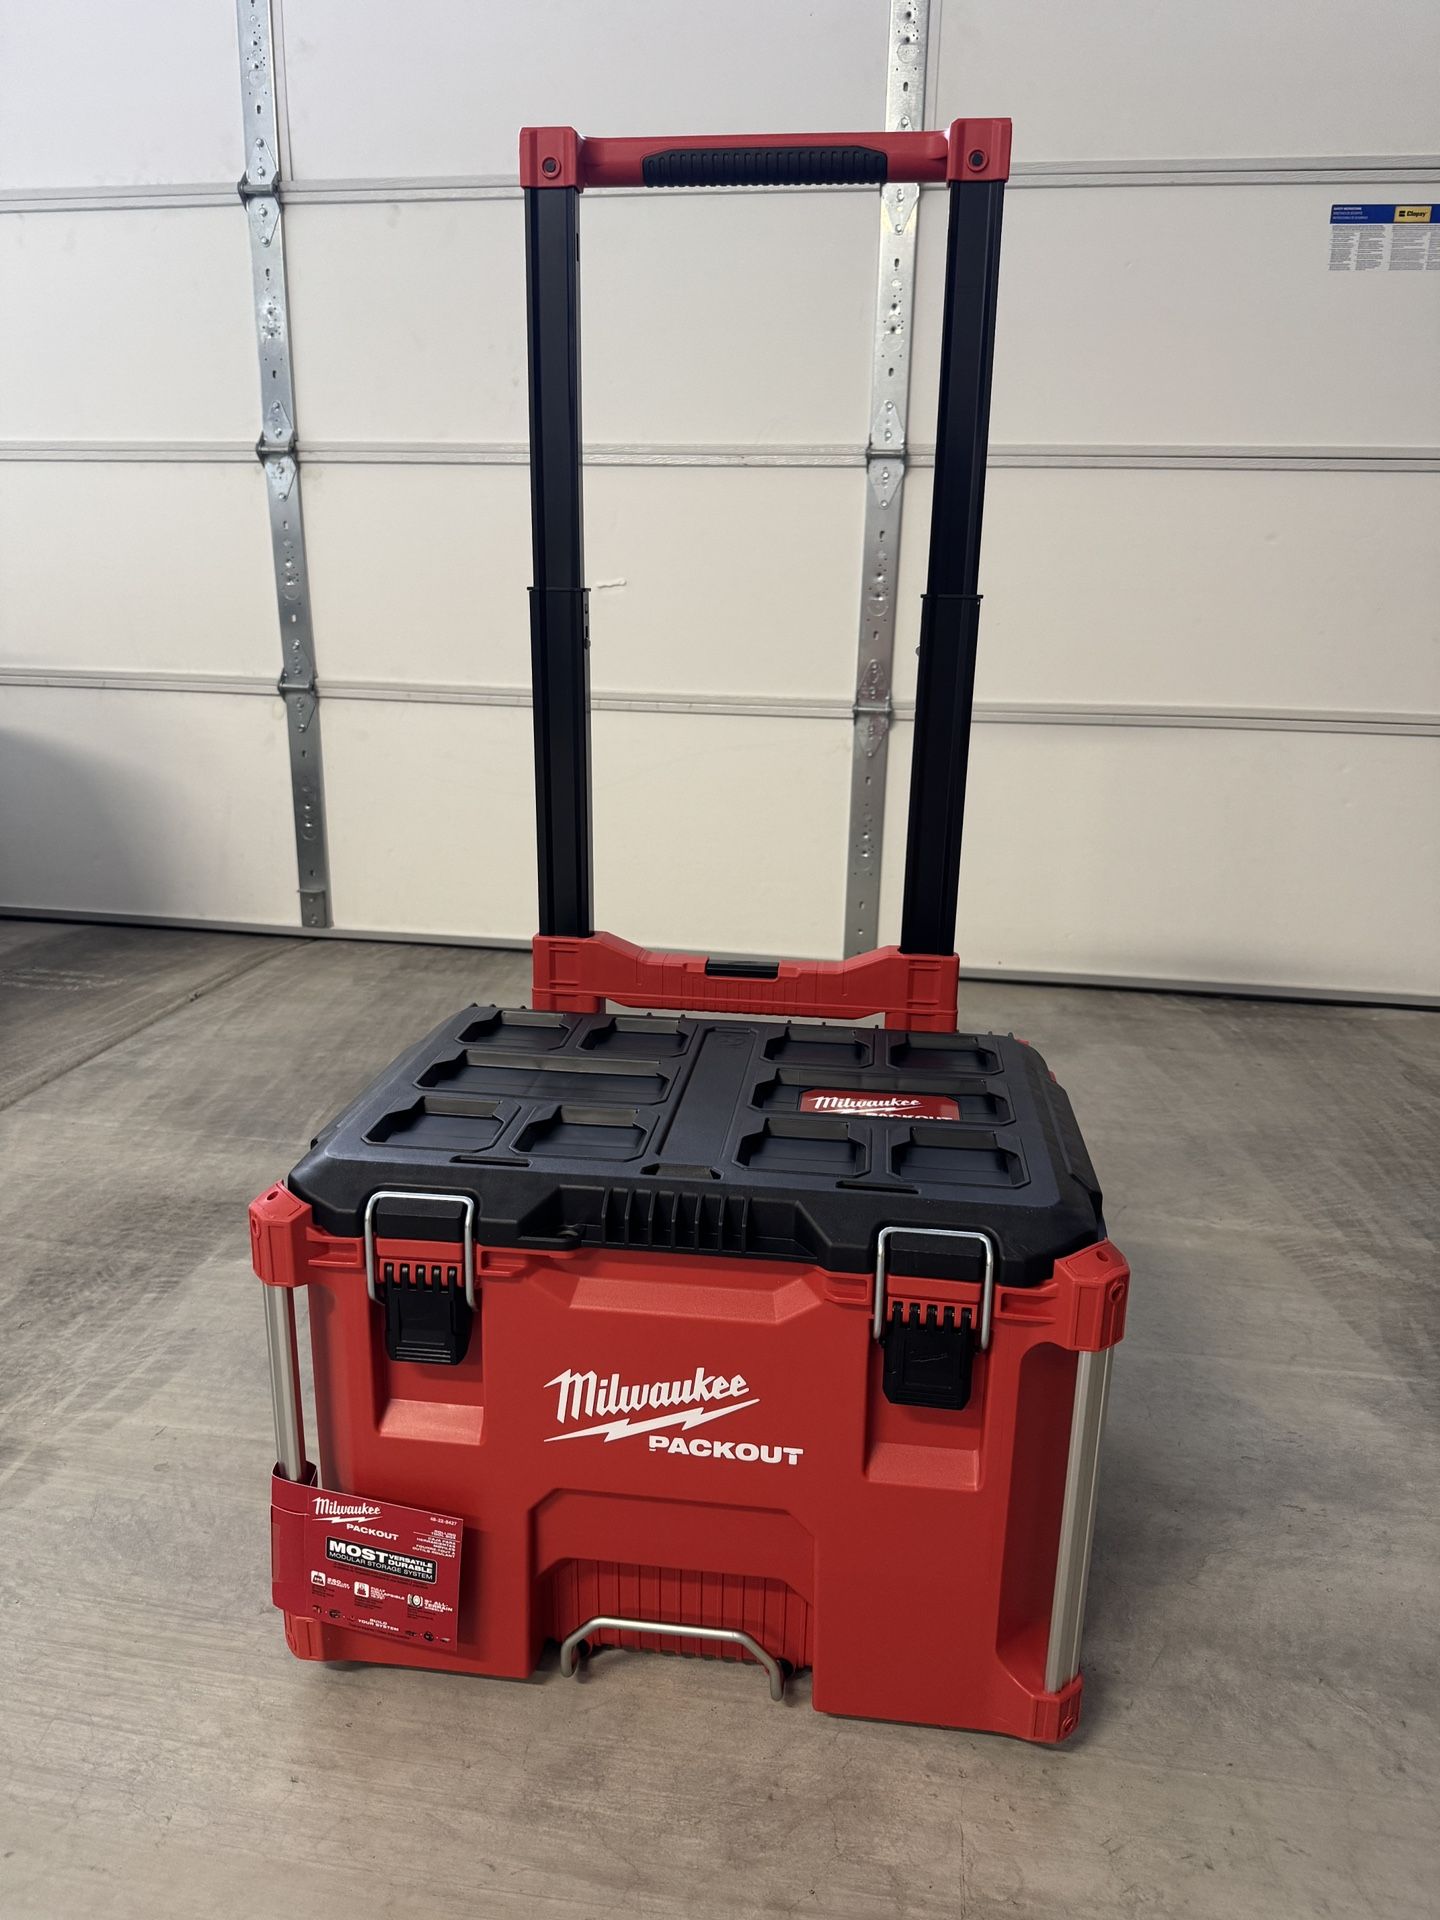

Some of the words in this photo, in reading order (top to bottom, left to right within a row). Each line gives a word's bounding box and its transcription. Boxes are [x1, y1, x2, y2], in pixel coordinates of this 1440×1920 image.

[808, 1096, 921, 1109] Milwaukee
[543, 1367, 750, 1424] Milwaukee
[649, 1435, 804, 1465] PACKOUT
[312, 1496, 381, 1516] Milwaukee
[346, 1523, 399, 1541] PACKOUT
[329, 1540, 388, 1563] MOST
[388, 1554, 433, 1568] VERSATILE
[329, 1551, 366, 1565] MODULAR
[367, 1561, 401, 1574] STORAGE
[403, 1569, 433, 1580] SYSTEM
[388, 1559, 433, 1574] DURABLE
